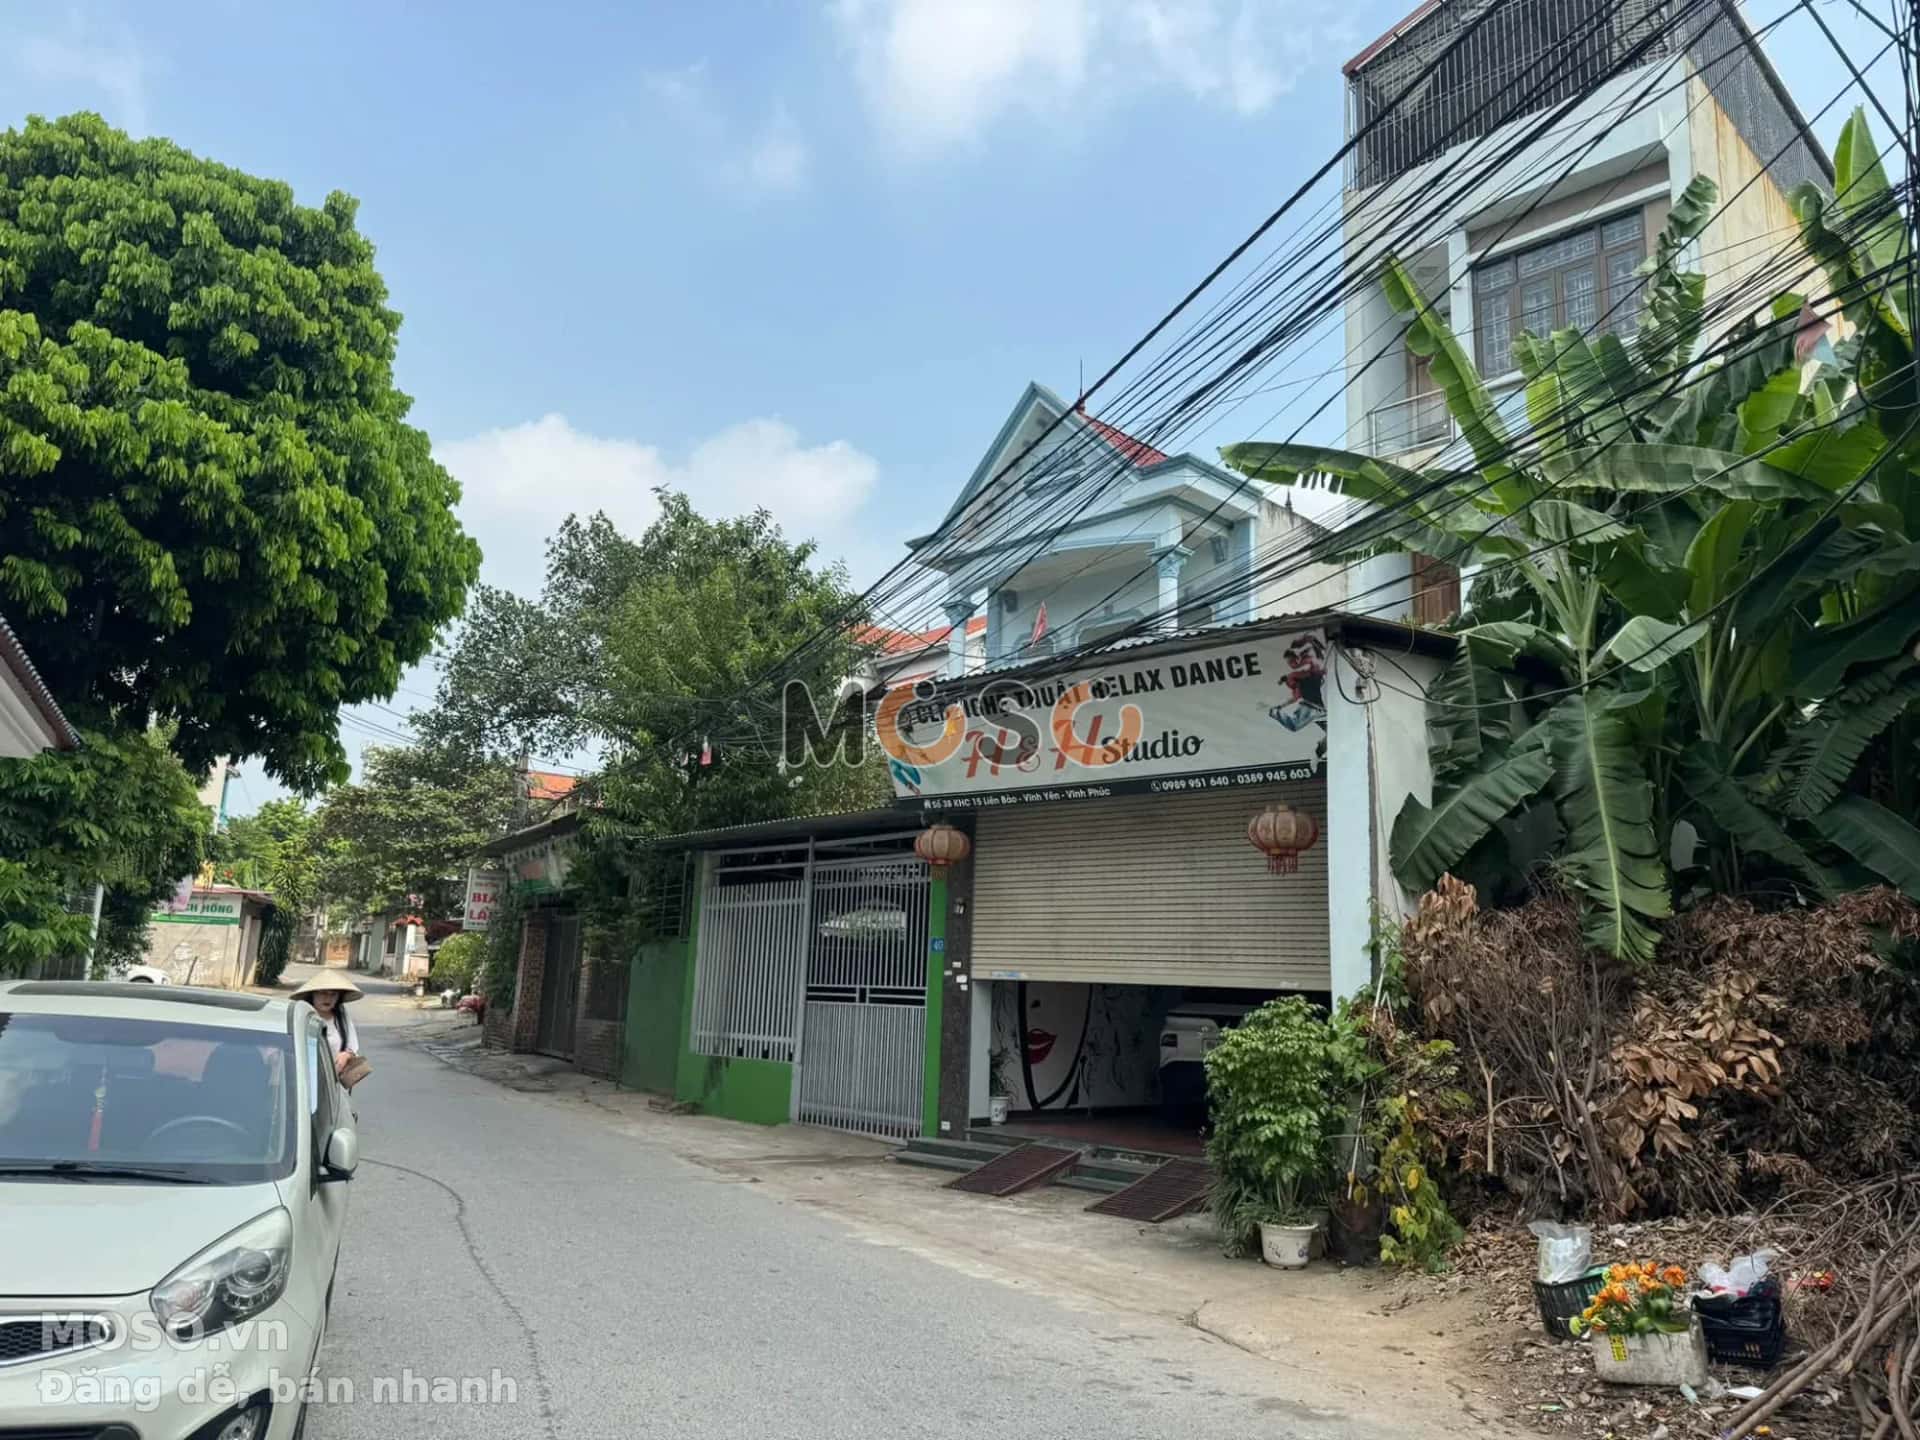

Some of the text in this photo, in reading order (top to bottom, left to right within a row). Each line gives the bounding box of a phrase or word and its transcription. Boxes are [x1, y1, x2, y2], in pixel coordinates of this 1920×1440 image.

[1169, 652, 1262, 688] DANCE
[1102, 729, 1206, 764] Studio
[1162, 780, 1187, 791] 0989
[1187, 778, 1206, 788] 951
[1209, 775, 1229, 786] 640
[1266, 769, 1287, 781] 945
[1290, 768, 1311, 779] 603
